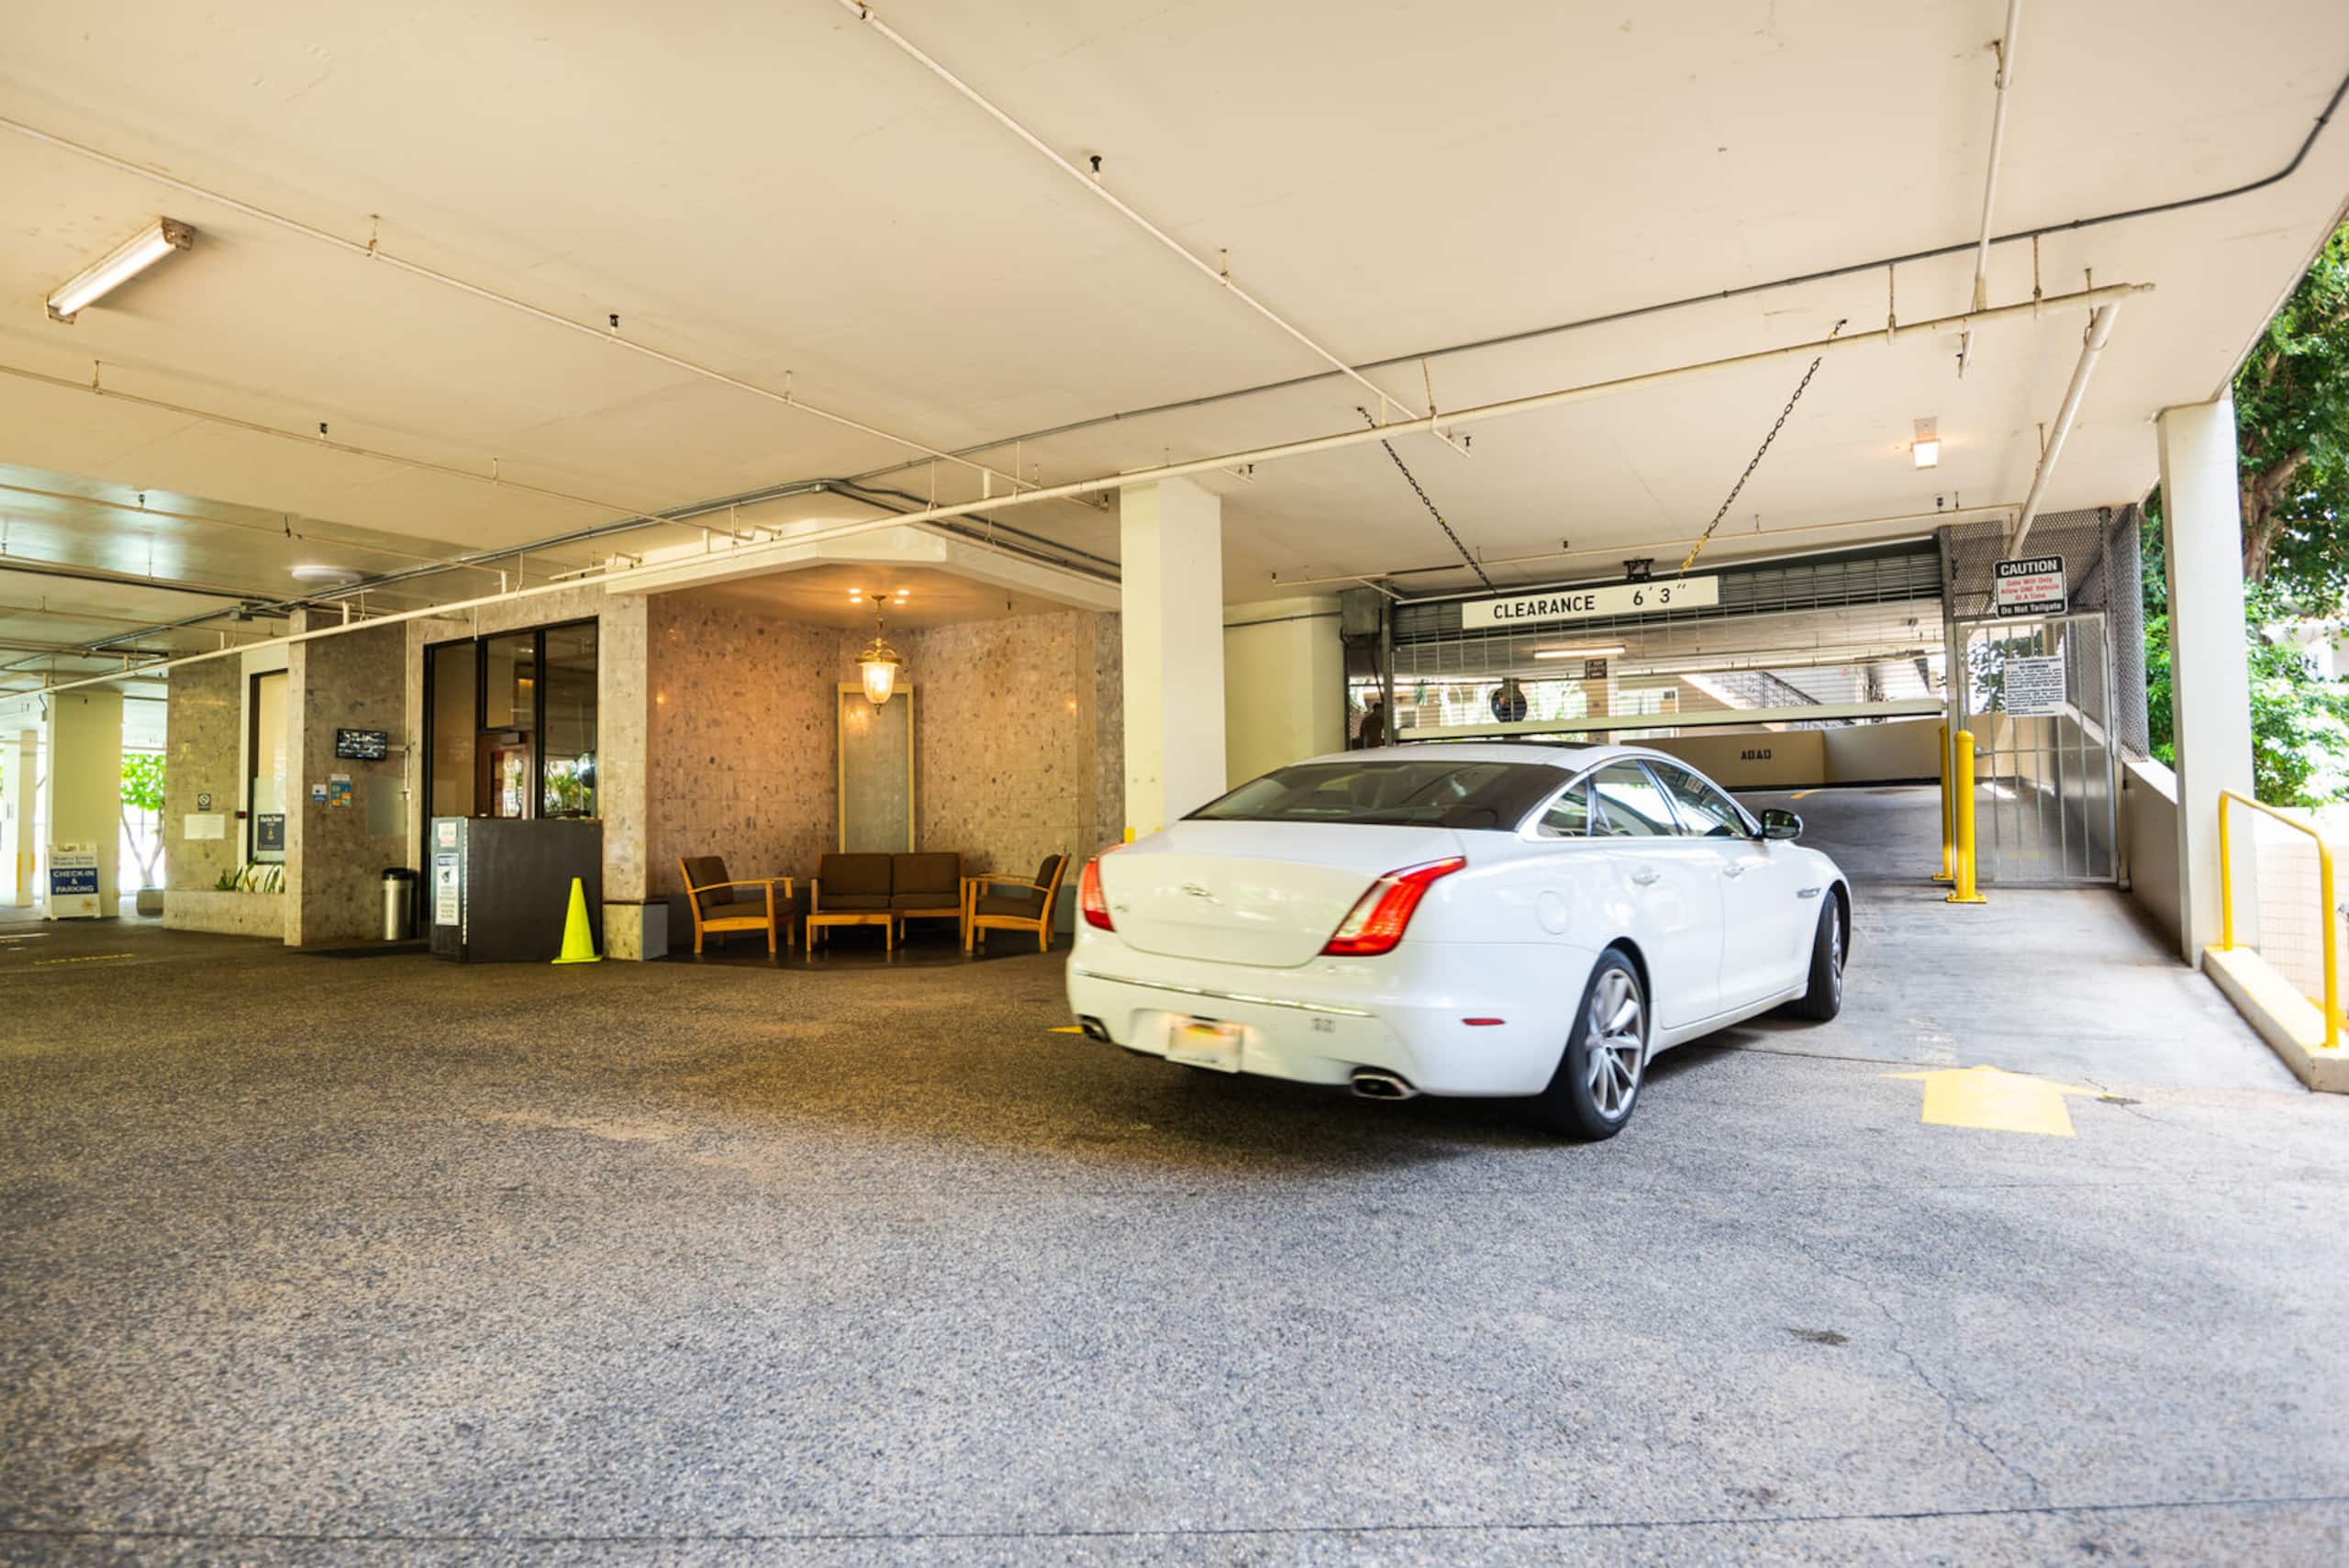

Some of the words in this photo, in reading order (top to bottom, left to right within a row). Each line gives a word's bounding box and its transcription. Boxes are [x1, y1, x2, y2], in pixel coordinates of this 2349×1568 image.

[2000, 560, 2057, 576] CAUTION
[2038, 576, 2053, 584] Only
[1494, 595, 1595, 619] CLEARANCE
[2000, 606, 2012, 615] Do
[2014, 606, 2028, 614] Not
[2031, 603, 2062, 613] Tailgate
